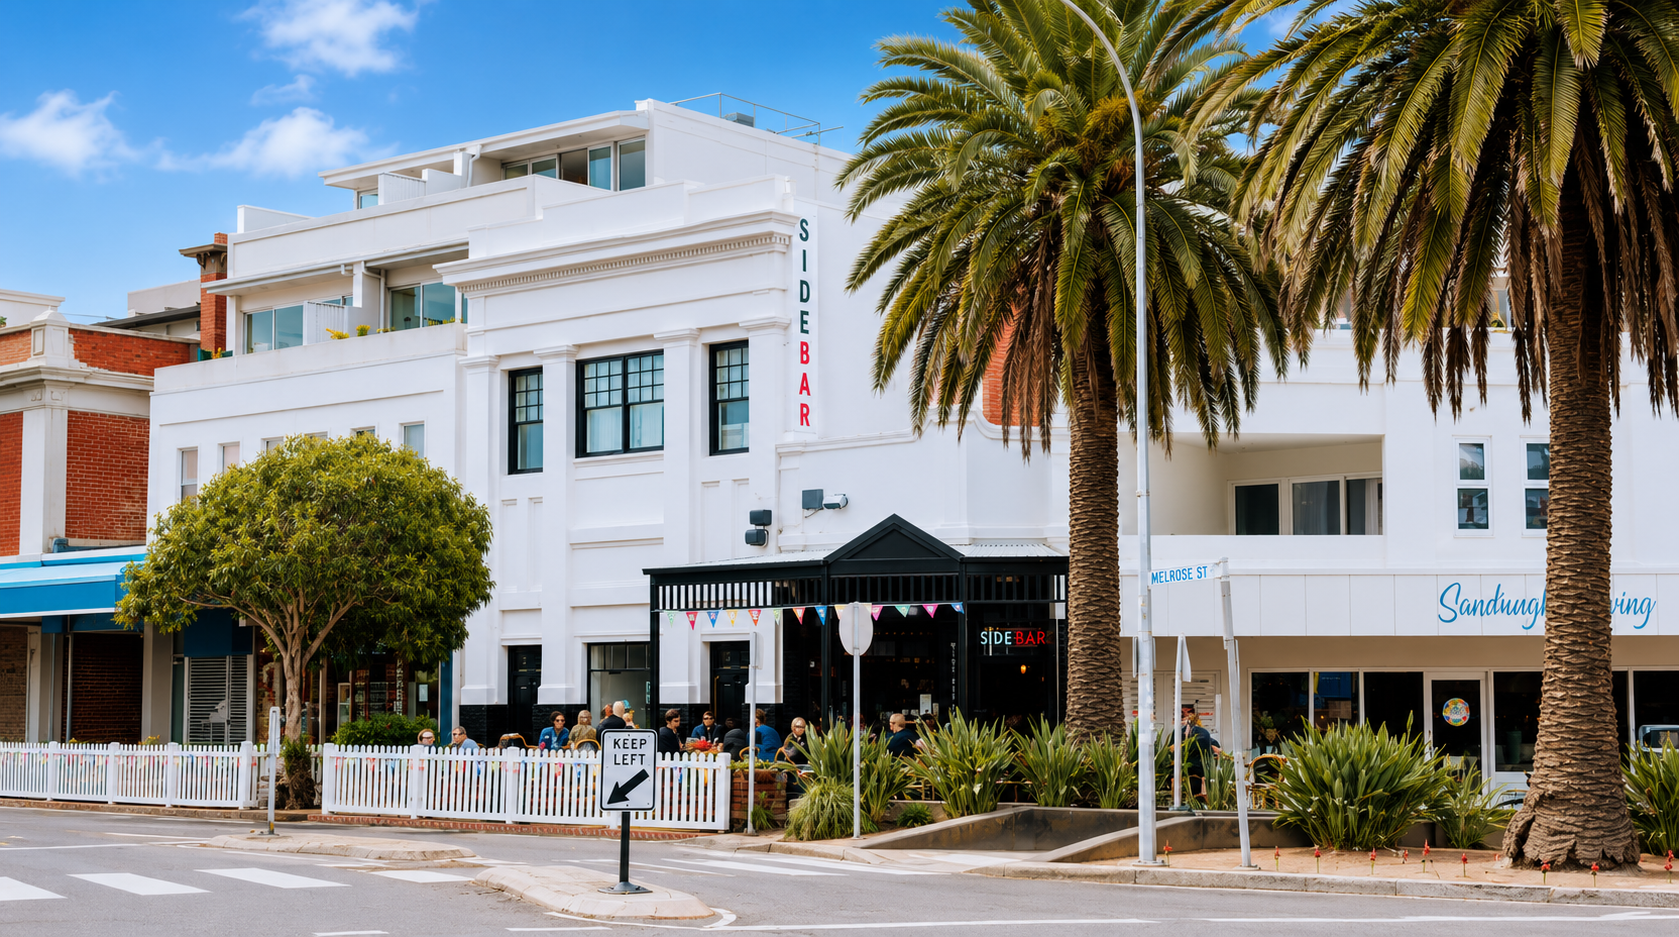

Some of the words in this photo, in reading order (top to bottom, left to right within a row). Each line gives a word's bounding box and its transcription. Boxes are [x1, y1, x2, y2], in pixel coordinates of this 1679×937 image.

[799, 218, 811, 427] SIDEBAR
[1151, 567, 1193, 585] MELROSE
[1196, 565, 1208, 579] ST
[1610, 591, 1657, 629] ving
[613, 738, 647, 749] KEEP
[614, 754, 646, 765] LEFT
